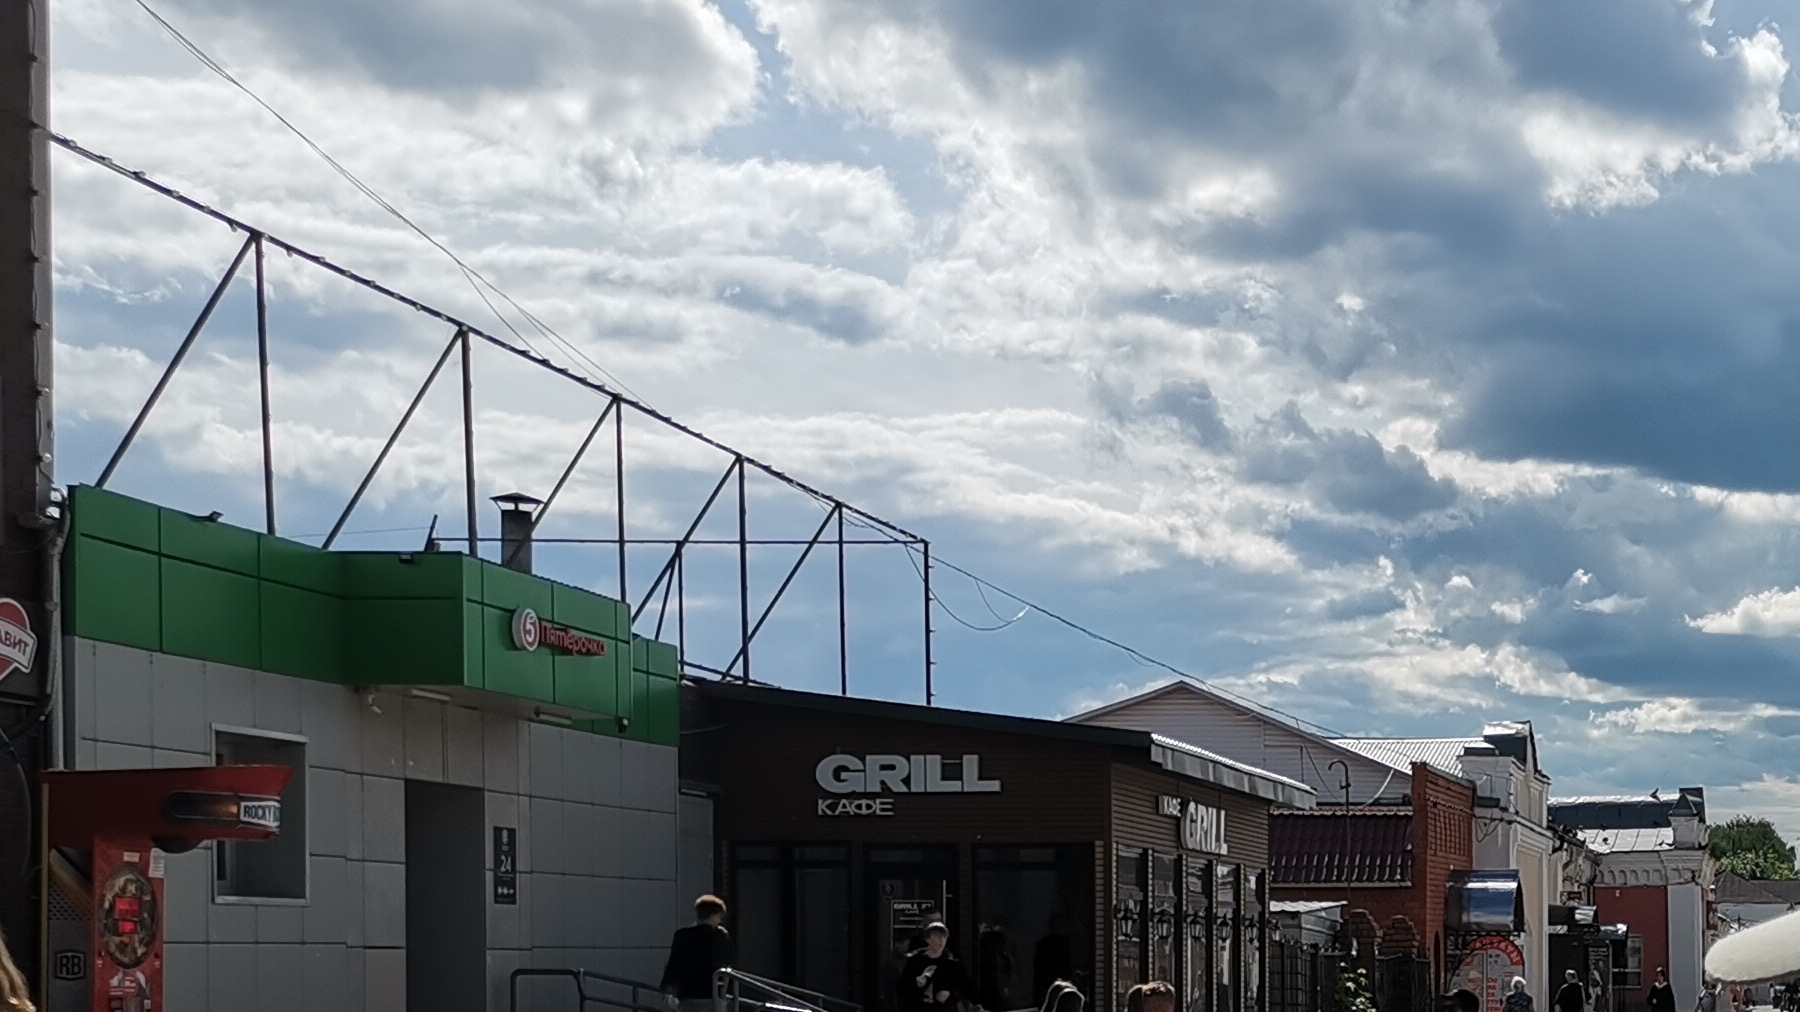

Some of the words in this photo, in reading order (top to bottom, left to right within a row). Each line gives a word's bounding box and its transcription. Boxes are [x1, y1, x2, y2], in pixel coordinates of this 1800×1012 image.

[0, 629, 29, 657] ВИТ
[541, 620, 607, 657] Пятёрочка
[815, 754, 1002, 794] GRILL
[817, 798, 896, 816] КАФЕ
[1181, 801, 1228, 855] GRILL
[500, 854, 512, 872] 24
[59, 955, 82, 975] RB
